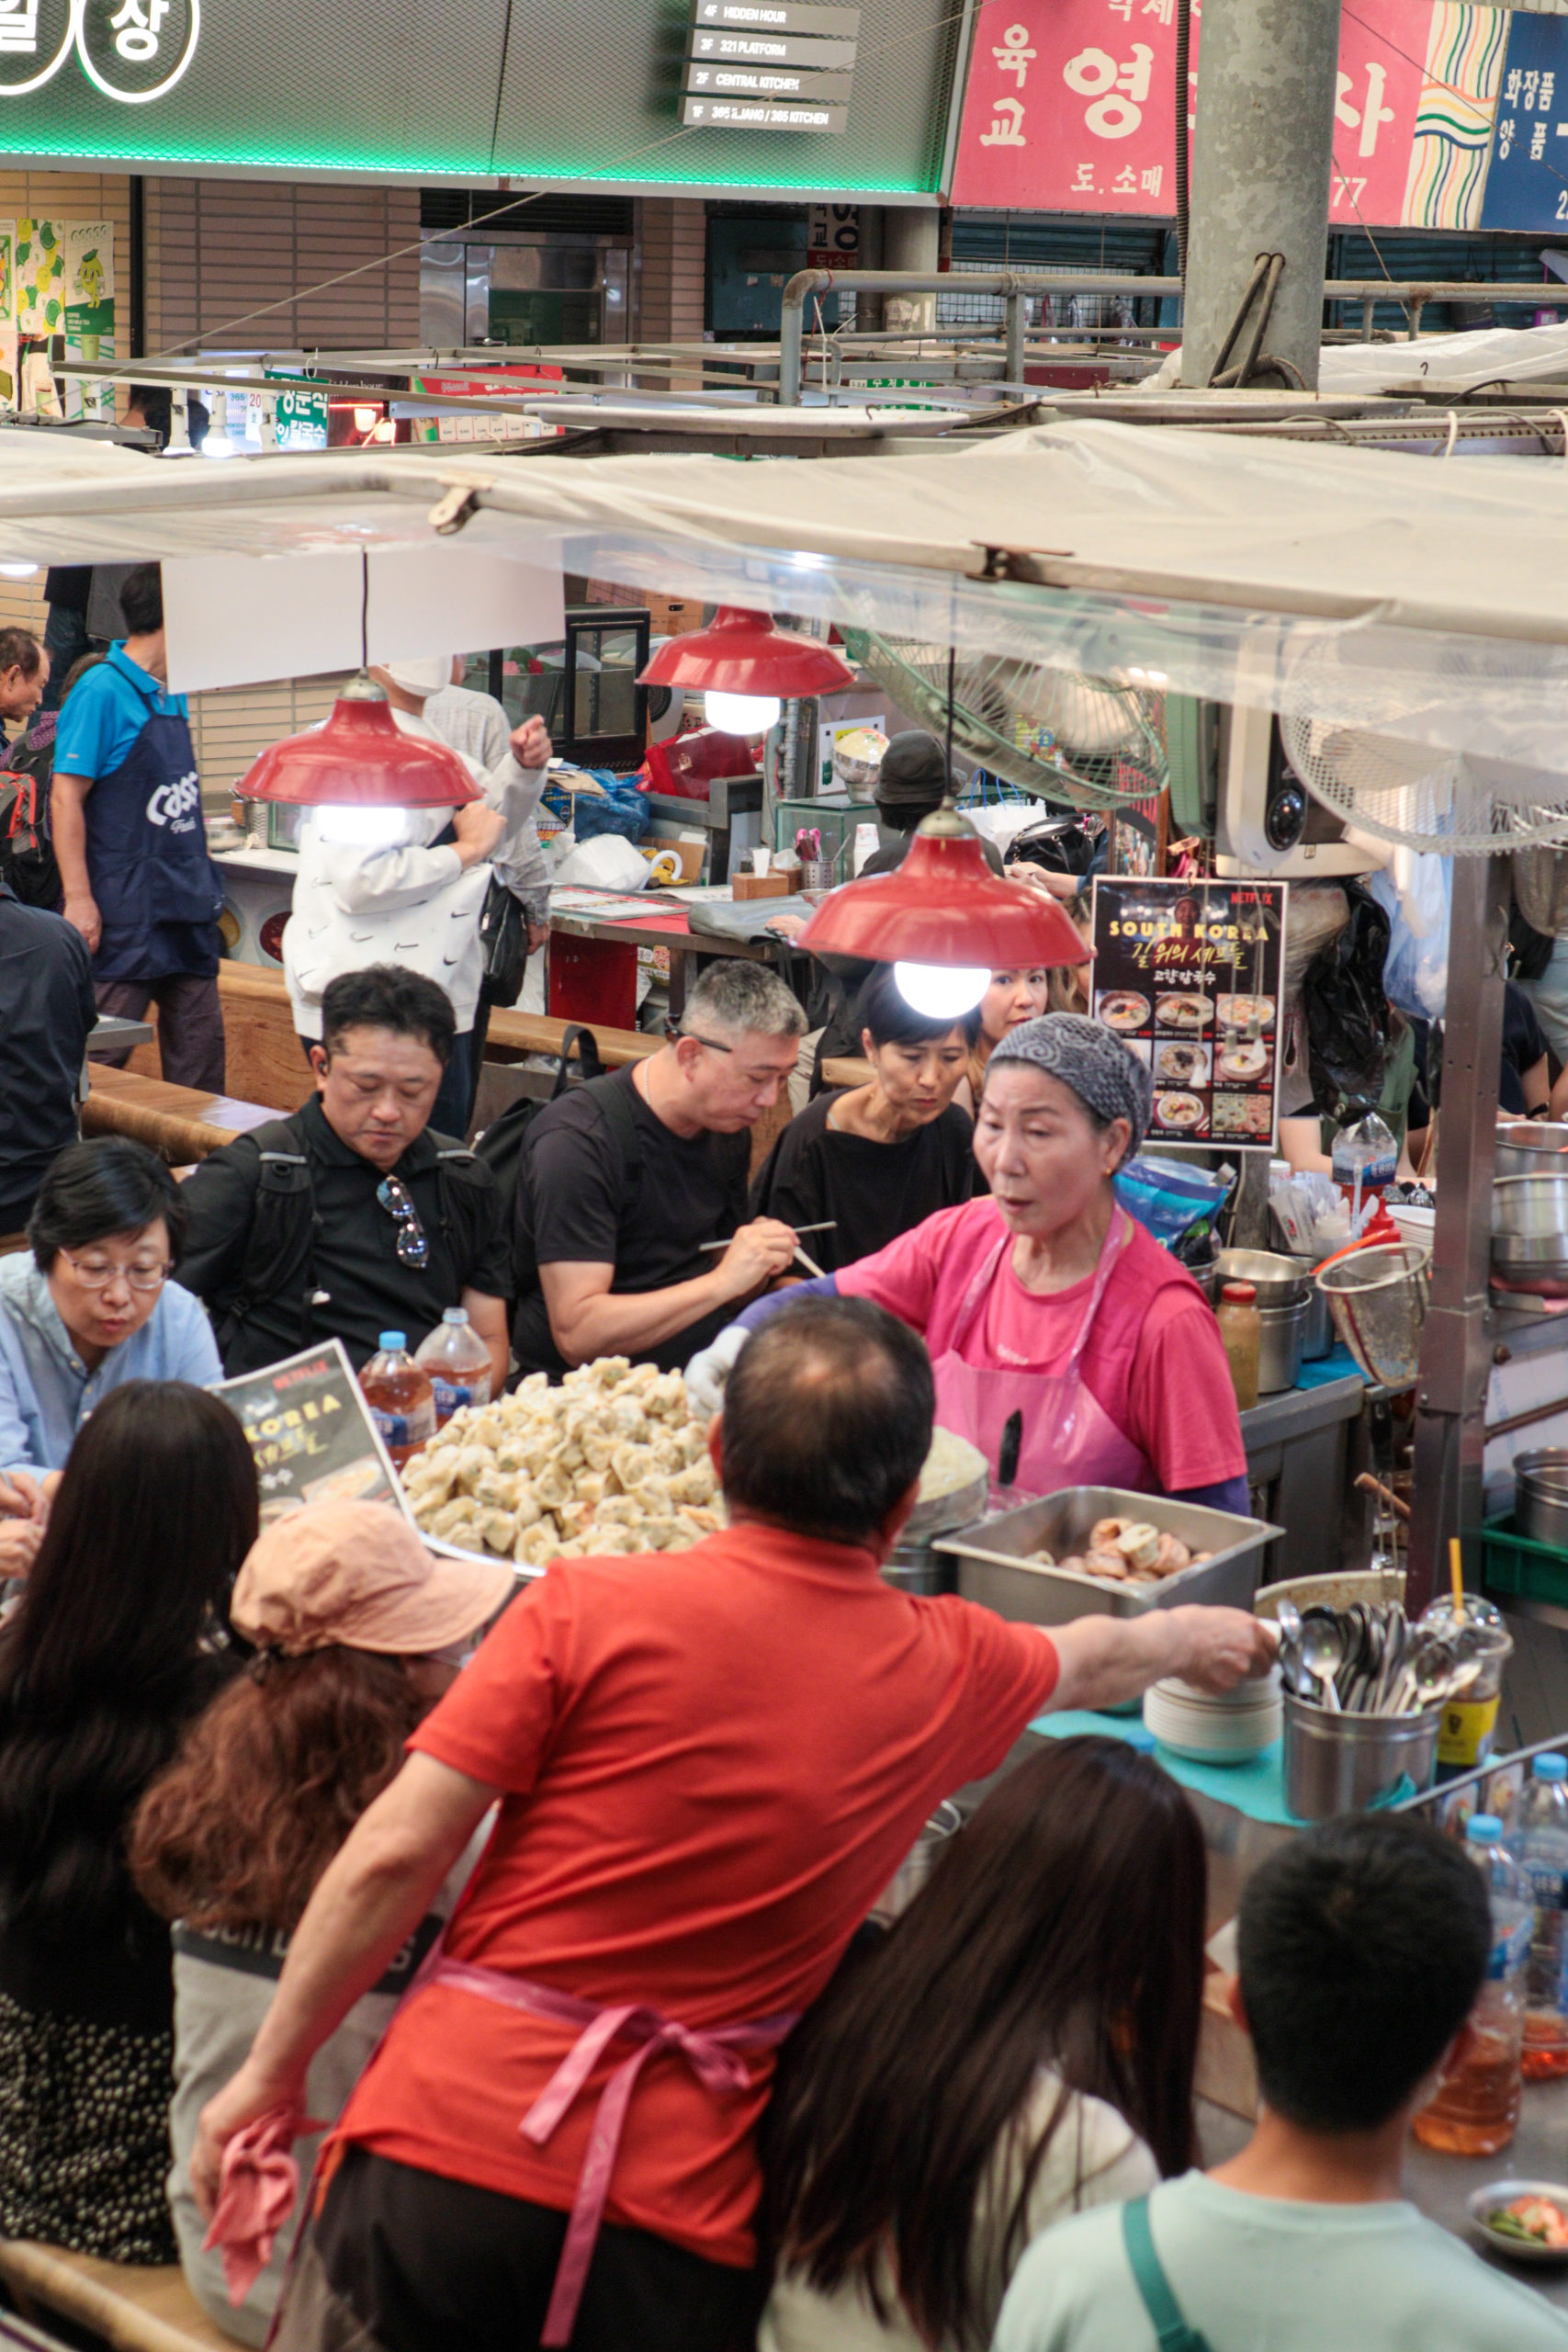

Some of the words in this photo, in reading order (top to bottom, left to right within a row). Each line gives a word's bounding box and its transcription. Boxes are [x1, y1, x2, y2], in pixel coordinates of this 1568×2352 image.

[704, 5, 717, 17] 4F
[723, 6, 759, 21] HIDDEN
[759, 9, 787, 23] HOUR
[700, 39, 714, 51] 3F
[720, 40, 738, 52] 321
[738, 40, 786, 56] PLATFORM
[695, 72, 709, 85] 2F
[716, 74, 758, 87] CENTRAL
[759, 76, 800, 91] KITCHEN
[980, 24, 1037, 146] 육교
[1504, 68, 1555, 111] 화장품
[692, 106, 704, 118] 1F
[712, 106, 731, 119] 365
[771, 109, 789, 122] 365
[789, 111, 829, 125] KITCHEN
[249, 393, 262, 408] 20
[1230, 891, 1273, 906] NETFLIX
[1109, 920, 1183, 938] SOUTH
[1193, 923, 1269, 941] KOREA
[1132, 937, 1156, 968] 길
[1154, 942, 1190, 965] 위의
[1153, 968, 1217, 985] 고향칼국수
